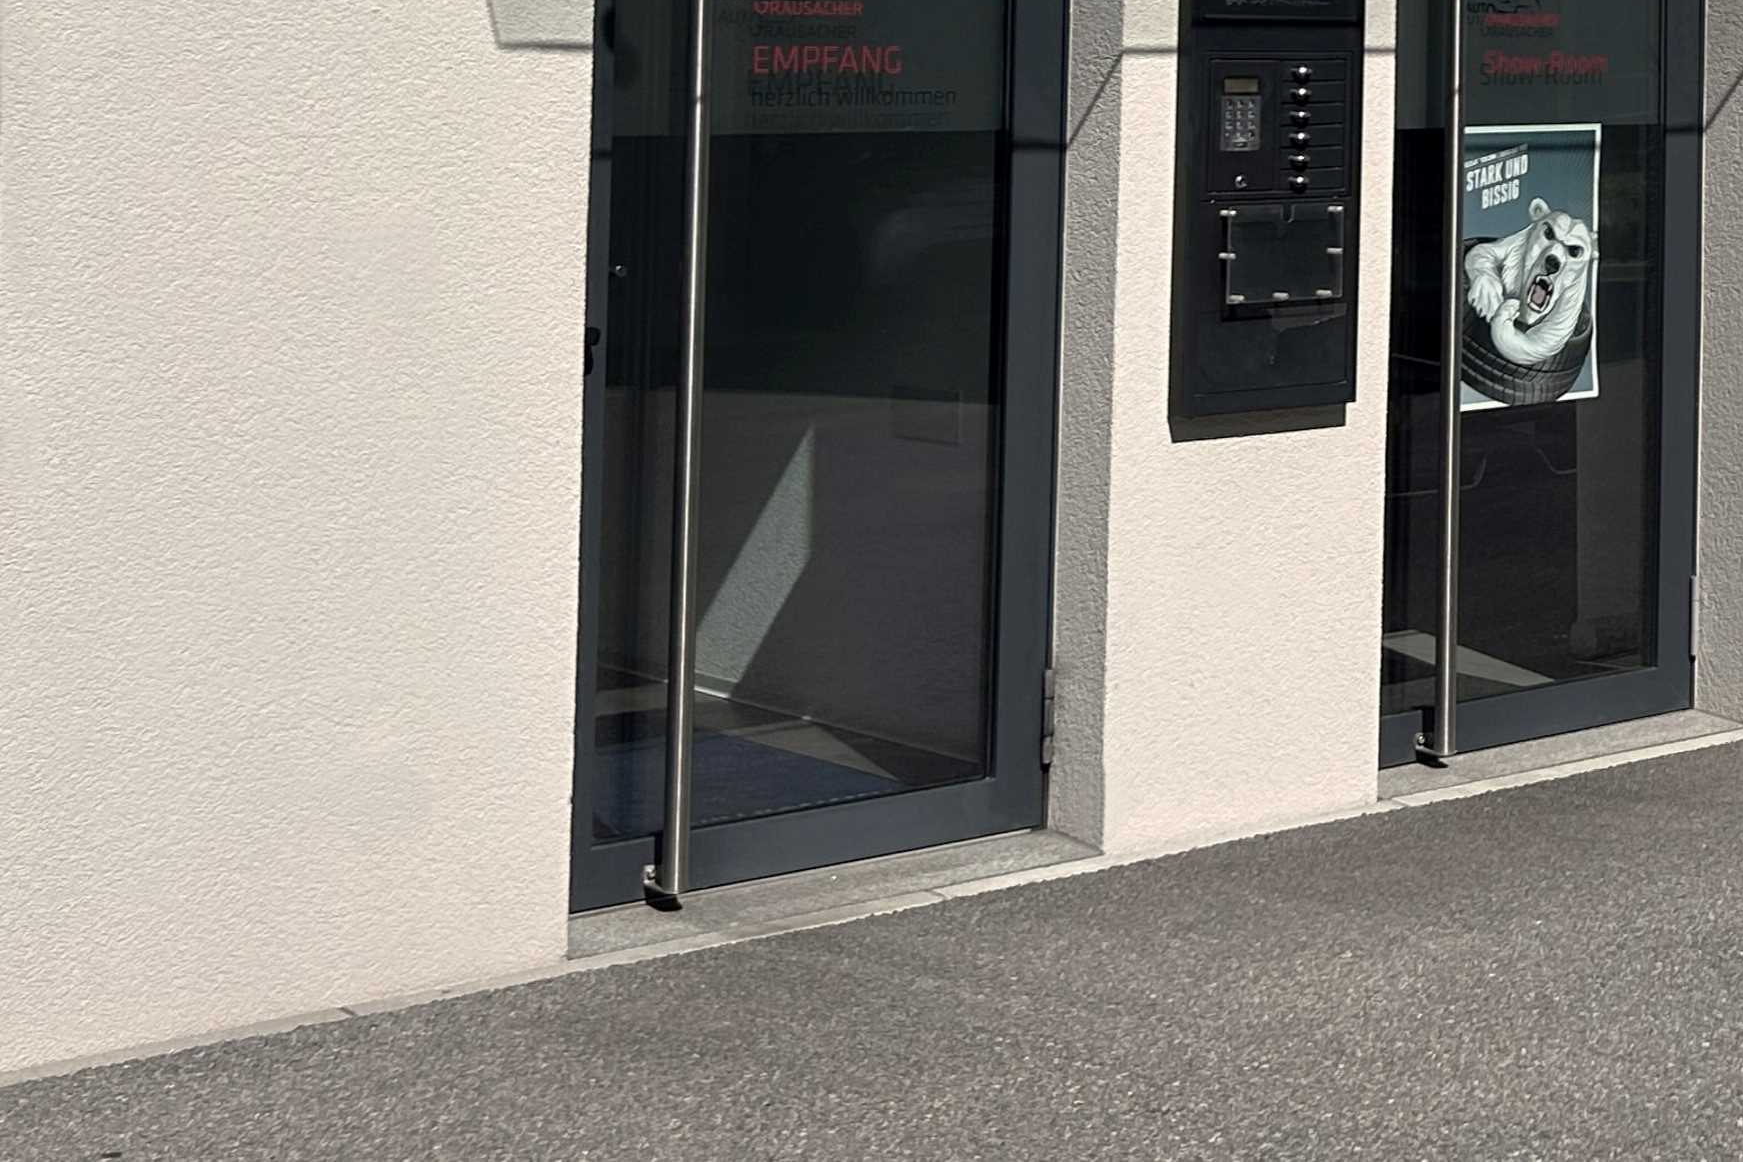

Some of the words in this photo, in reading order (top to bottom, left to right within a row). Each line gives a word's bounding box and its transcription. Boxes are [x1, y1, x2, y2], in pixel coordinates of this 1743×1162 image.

[752, 45, 903, 75] EMPFANG
[838, 87, 956, 106] willkommen
[1466, 161, 1504, 192] STARK
[1505, 154, 1528, 179] UND
[1481, 179, 1520, 209] BISSIG
